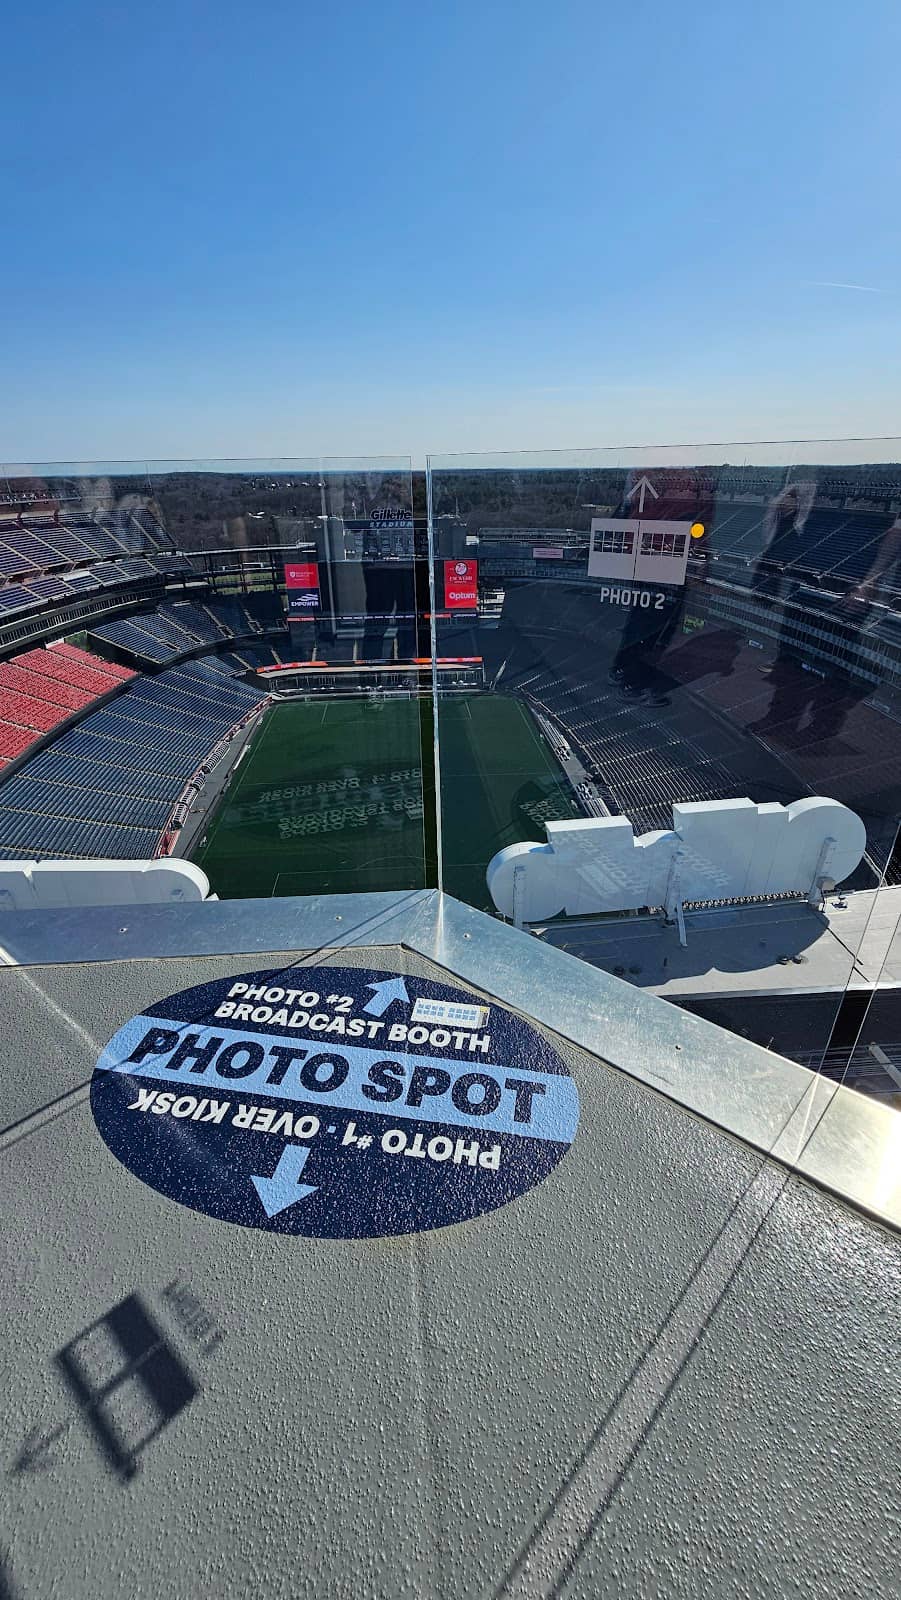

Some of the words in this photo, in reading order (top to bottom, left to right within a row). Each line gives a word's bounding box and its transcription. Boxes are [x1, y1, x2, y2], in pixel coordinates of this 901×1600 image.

[370, 508, 413, 520] Gillette
[449, 592, 476, 601] Optum
[600, 586, 651, 608] PHOTO
[654, 592, 666, 610] 2
[227, 982, 322, 1009] PHOTO
[326, 994, 354, 1014] #2
[213, 1001, 385, 1040] BROADCAST
[387, 1023, 492, 1053] BOOTH
[128, 1026, 350, 1094] PHOTO
[361, 1059, 547, 1125] SPOT
[128, 1088, 231, 1124] KIOSK
[237, 1104, 320, 1138] OVER
[341, 1120, 374, 1149] #1
[382, 1129, 502, 1170] PHOTO
